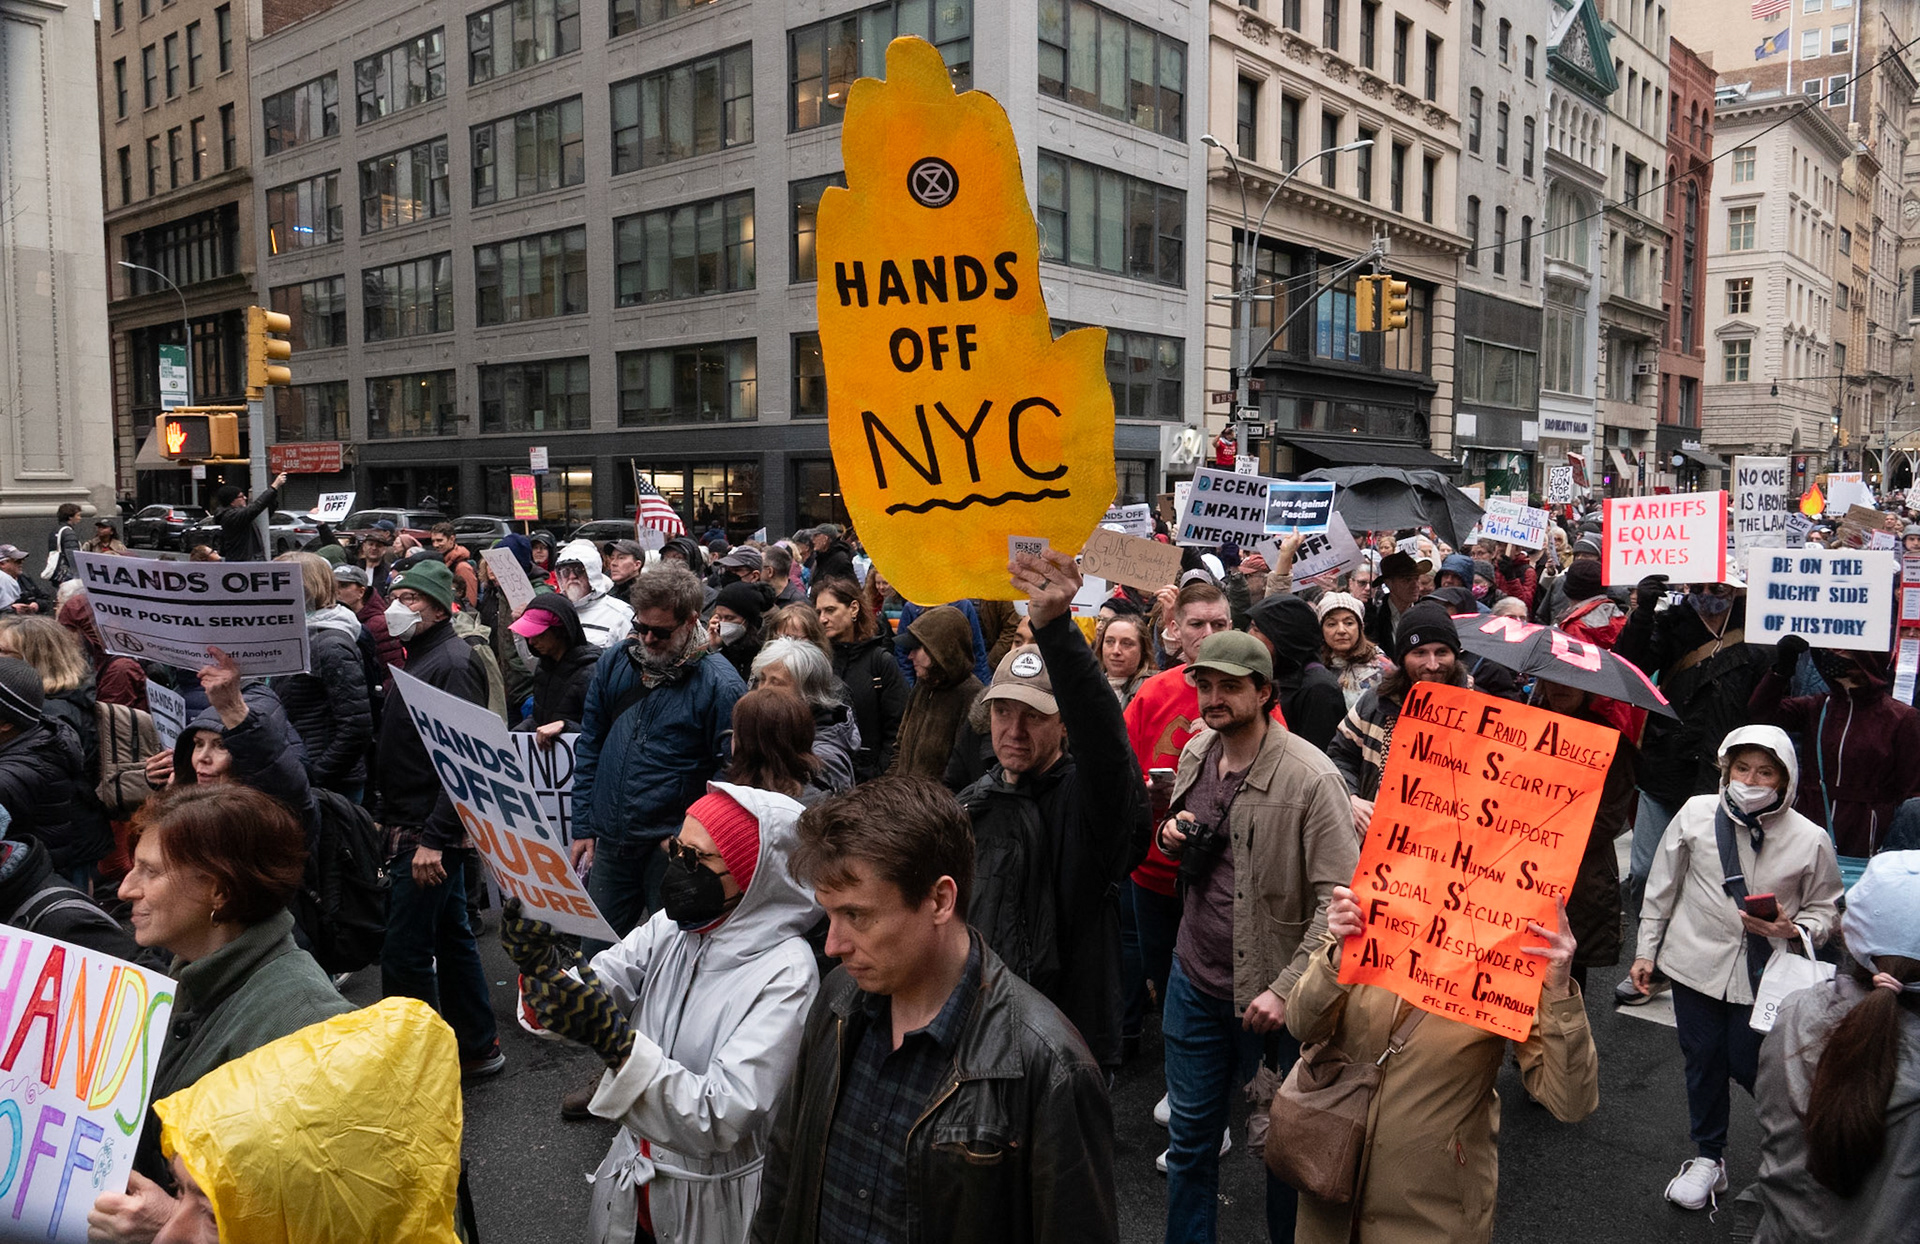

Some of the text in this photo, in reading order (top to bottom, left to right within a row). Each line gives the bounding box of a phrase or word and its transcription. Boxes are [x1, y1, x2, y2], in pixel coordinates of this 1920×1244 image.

[835, 251, 1018, 307] HANDS
[889, 324, 978, 372] OFF
[1573, 421, 1588, 433] SALON
[286, 448, 297, 458] FOR
[861, 397, 1069, 489] NYC
[283, 459, 300, 469] LEASE
[1551, 467, 1570, 478] STOP
[1198, 475, 1268, 498] DECENC
[1550, 476, 1570, 486] ELON
[1739, 468, 1785, 487] NO ONE
[326, 494, 348, 502] HANDS
[1550, 486, 1569, 495] STOP
[324, 501, 346, 512] OFF!
[1270, 499, 1329, 509] Jews Against
[1618, 500, 1707, 521] TARIFFS
[1741, 493, 1787, 512] IS ABOVE
[1105, 511, 1144, 520] NDS OFF
[1281, 510, 1317, 519] Fascism
[1739, 514, 1787, 532] THE LAW
[1790, 518, 1809, 530] OFF
[1185, 523, 1271, 547] INTEGRITY
[1618, 524, 1691, 545] EQUAL
[1094, 533, 1136, 558] GUAC
[1116, 557, 1136, 576] THIS
[1621, 548, 1689, 566] TAXES
[1771, 556, 1863, 576] BE ON THE
[86, 562, 291, 593] HANDS OFF
[1767, 583, 1869, 604] RIGHT SIDE
[95, 602, 294, 627] OUR POSTAL SERVICE!
[1763, 614, 1866, 636] OF HISTORY
[147, 641, 202, 659] Organization
[242, 648, 282, 659] Analysts
[148, 687, 173, 713] HANDS
[410, 704, 525, 783] HANDS
[1534, 720, 1610, 768] ABUSE:
[1410, 731, 1579, 805] NATIONAL SECURITY
[432, 748, 550, 840] OFF!
[1401, 774, 1565, 849] VETERAN'S SUPPORT
[456, 802, 580, 891] OUR
[1386, 823, 1439, 863] HEALTH
[1450, 841, 1505, 884] HUMAN
[1371, 862, 1546, 938] SOCIAL SECURITY
[1368, 898, 1537, 978] FIRST RESPONDERS
[1359, 937, 1395, 971] AIR
[1409, 948, 1459, 997] TRAFFIC
[0, 936, 173, 1137] HANDS
